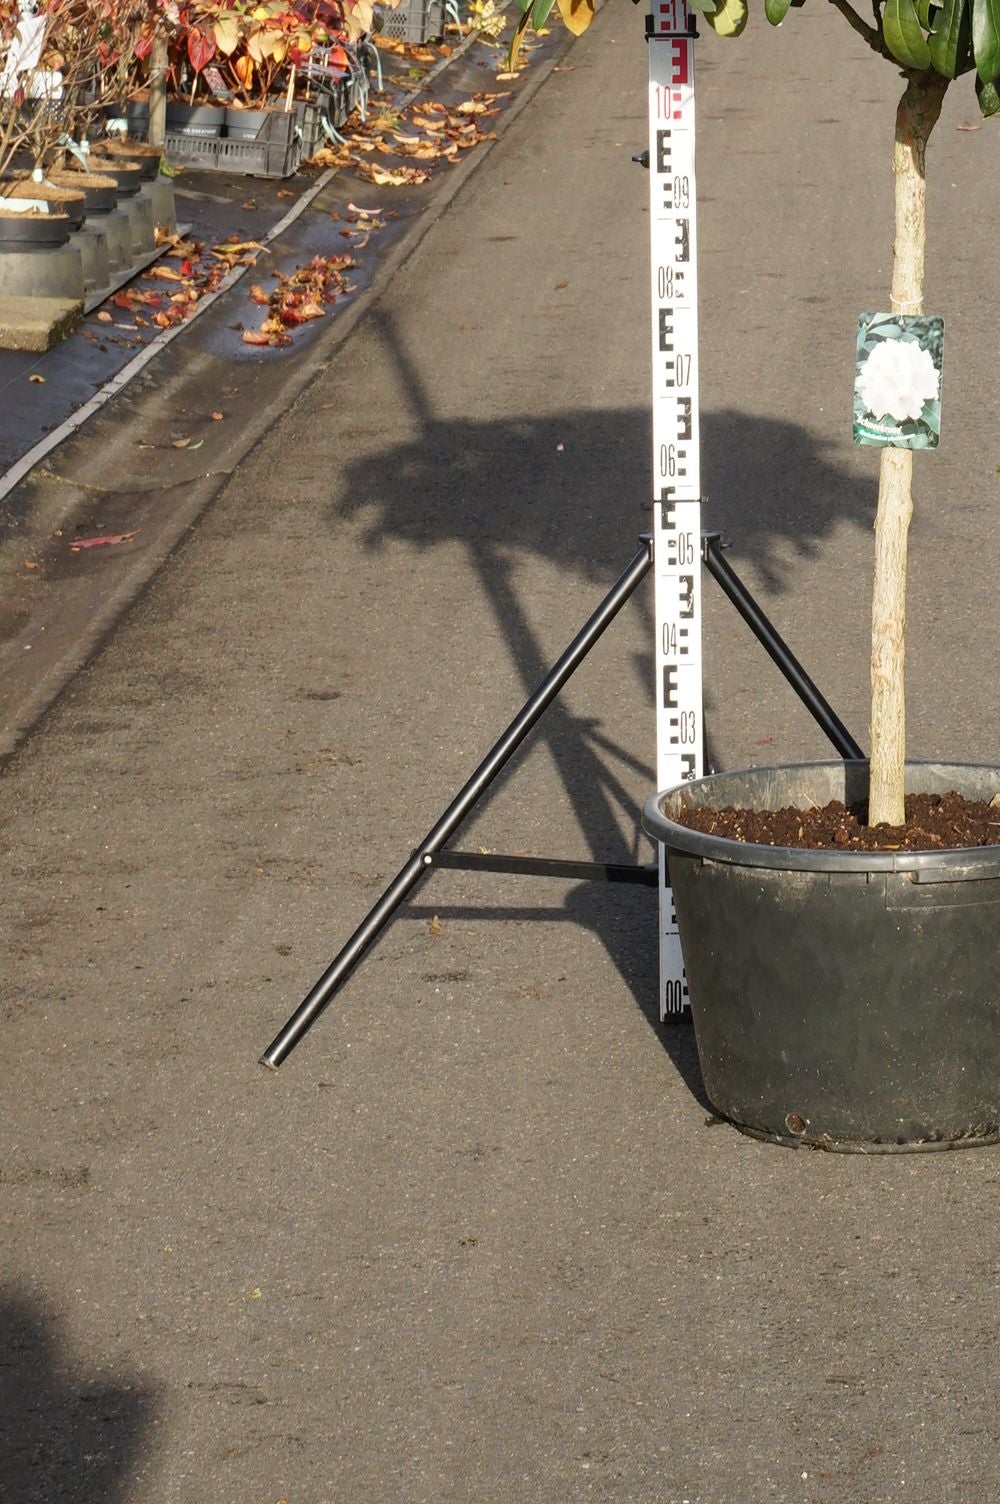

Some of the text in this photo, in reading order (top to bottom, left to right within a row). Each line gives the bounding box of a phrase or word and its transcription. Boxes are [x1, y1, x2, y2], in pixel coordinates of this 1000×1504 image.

[655, 86, 671, 120] 10
[673, 175, 689, 209] 09
[658, 265, 673, 299] 08
[676, 354, 691, 387] 07
[660, 444, 675, 477] 06
[678, 532, 694, 565] 05
[662, 622, 677, 656] 04
[680, 711, 696, 744] 03
[666, 980, 681, 1013] 00
